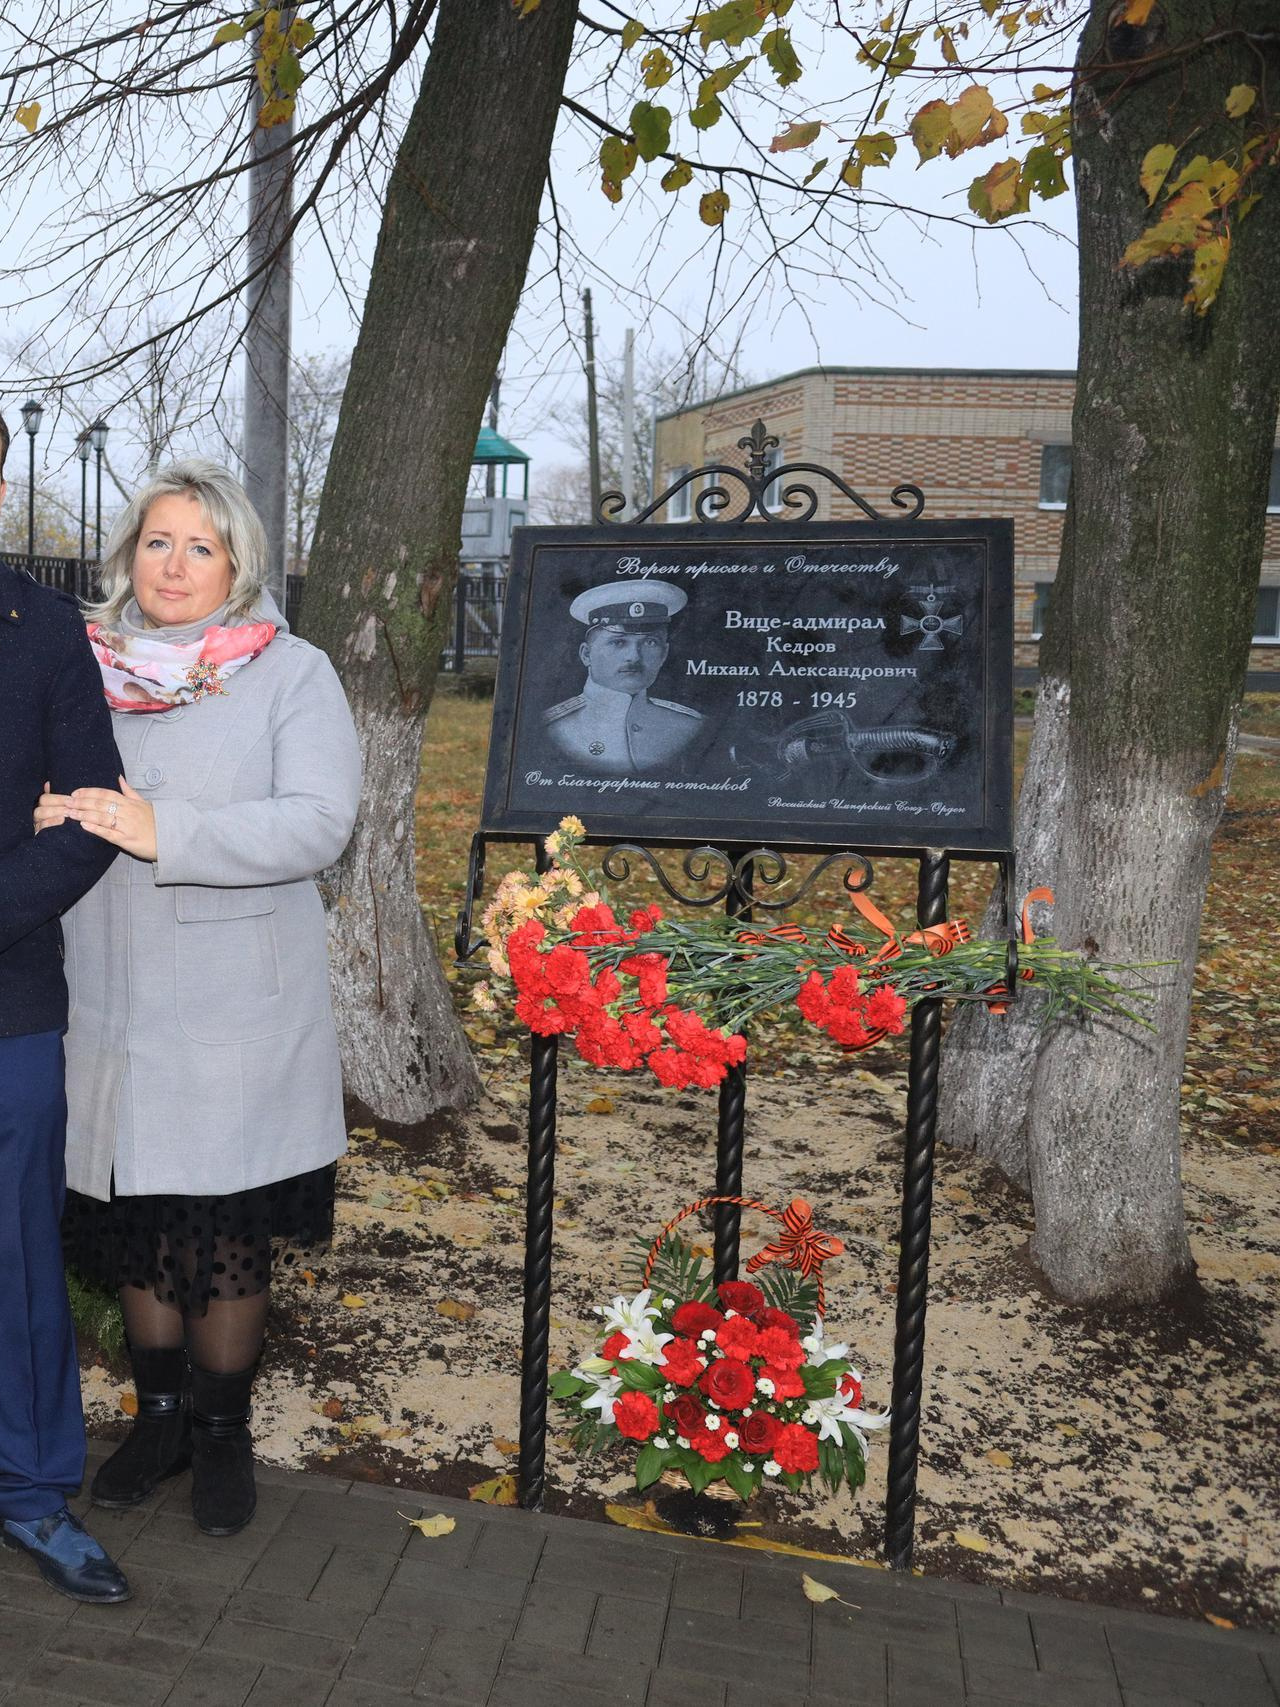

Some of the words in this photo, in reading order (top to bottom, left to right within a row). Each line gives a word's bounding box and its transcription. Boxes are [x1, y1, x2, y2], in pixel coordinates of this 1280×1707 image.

[616, 555, 680, 579] Верен
[684, 561, 758, 578] присяге
[762, 564, 775, 572] и
[784, 554, 898, 578] Отечеству
[725, 612, 886, 632] Вице-адмирал
[766, 636, 835, 655] Кедров
[686, 660, 760, 680] Михаил
[768, 661, 916, 680] Александрович
[737, 690, 782, 706] 1878
[810, 692, 856, 708] 1945
[524, 771, 553, 785] От
[557, 774, 660, 793] благодарных
[664, 778, 751, 791] потомков
[767, 796, 826, 808] Российский
[828, 798, 892, 812] Имперский
